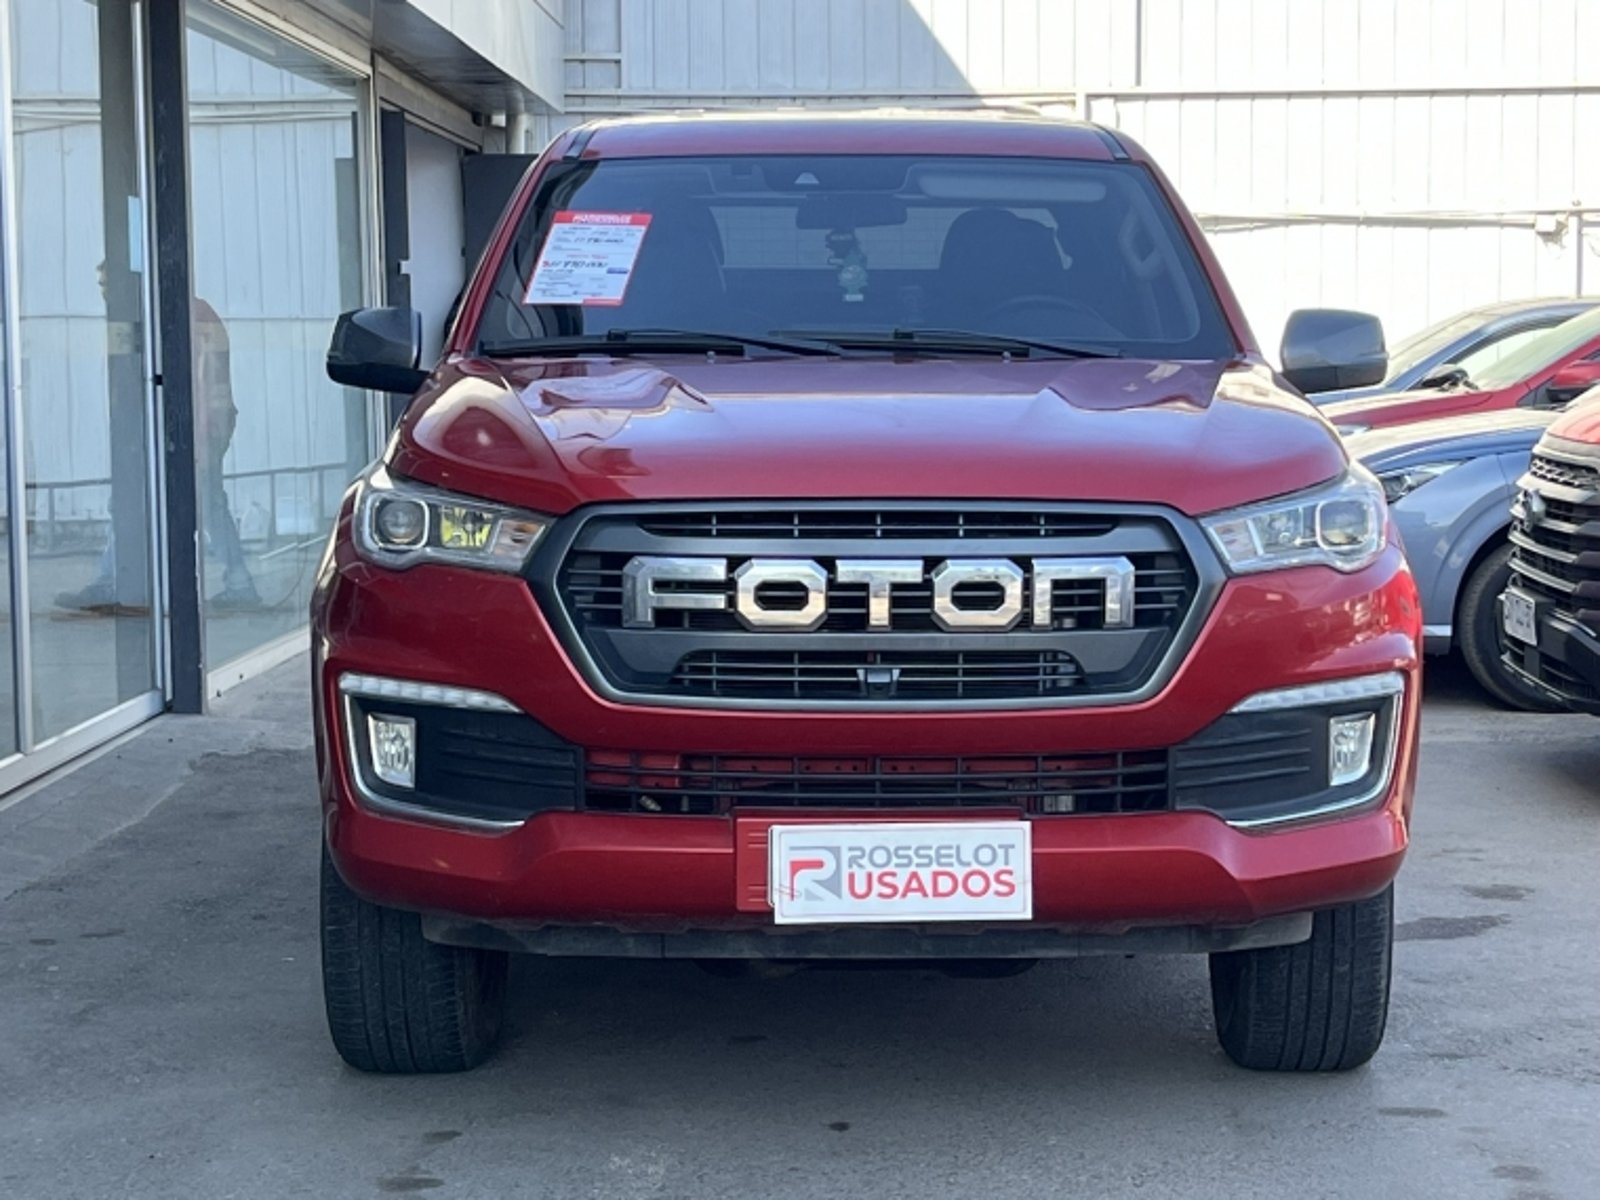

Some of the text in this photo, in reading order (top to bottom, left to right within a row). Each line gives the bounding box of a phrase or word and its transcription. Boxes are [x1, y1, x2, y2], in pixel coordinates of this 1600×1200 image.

[621, 556, 1135, 631] FOTON
[847, 843, 1016, 869] ROSSELOT
[847, 869, 1017, 900] USADOS
